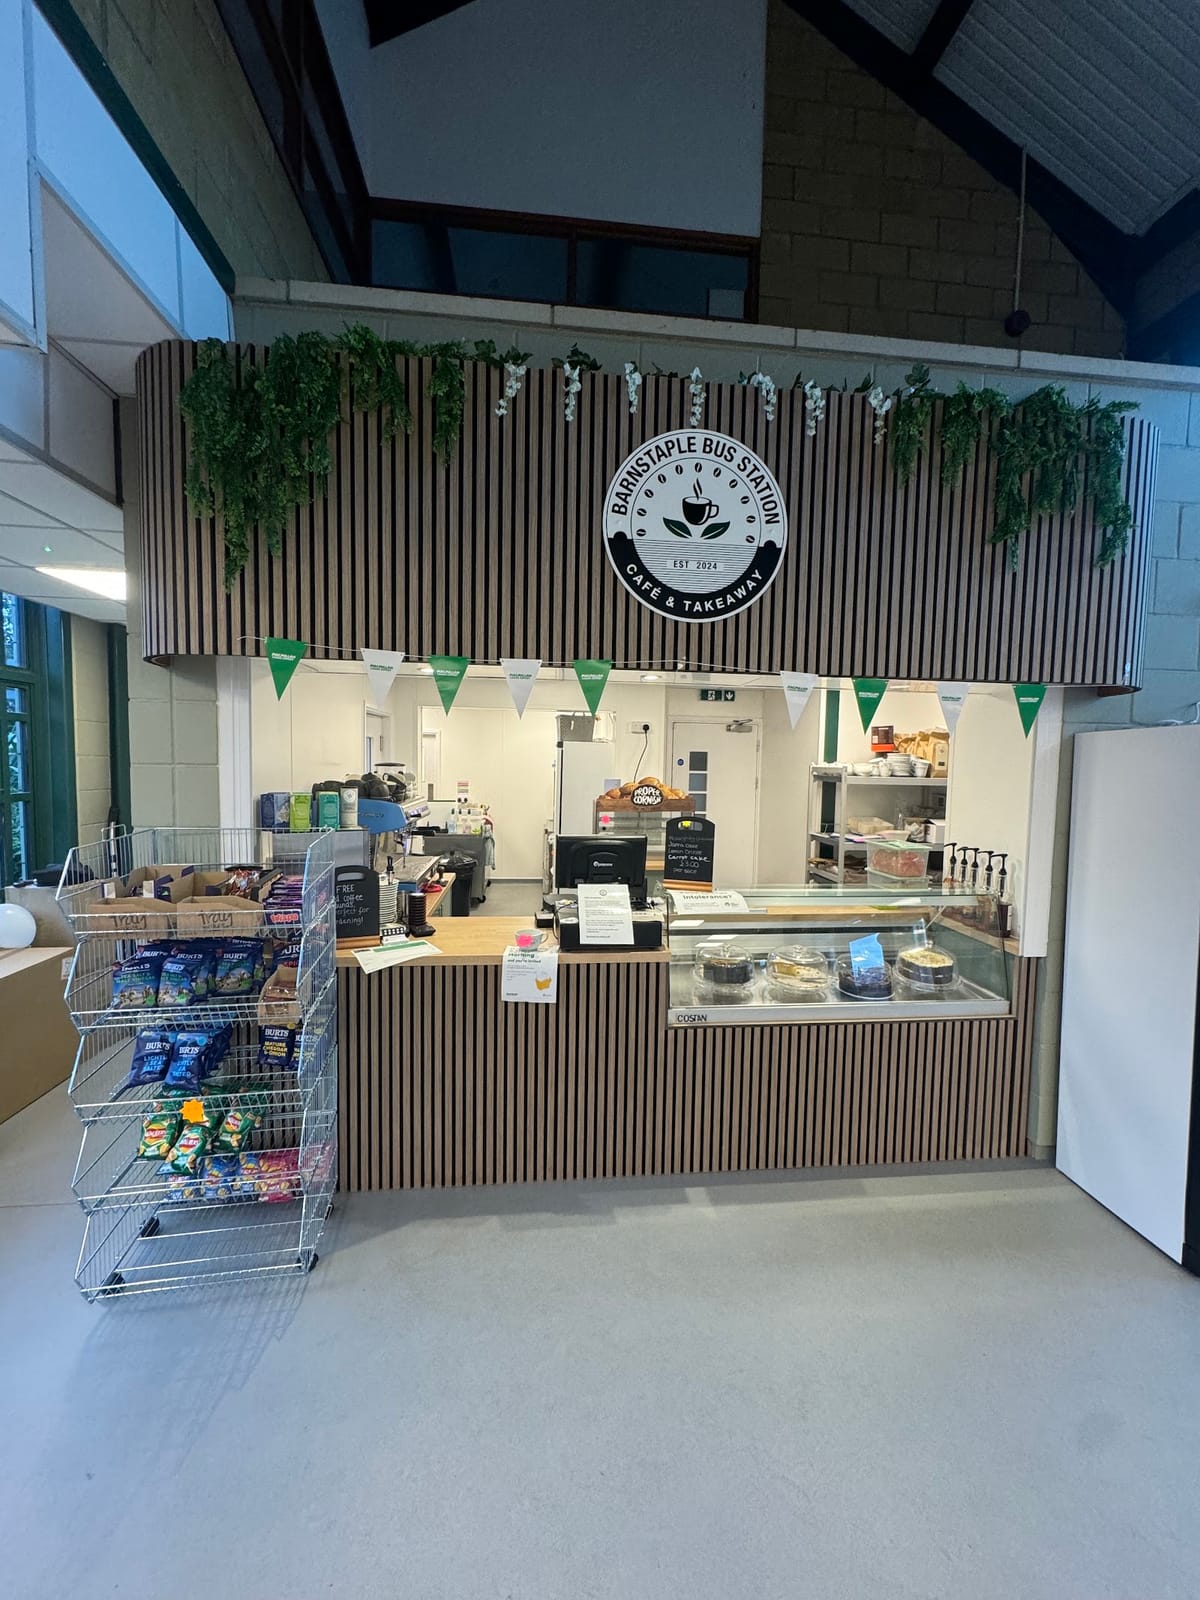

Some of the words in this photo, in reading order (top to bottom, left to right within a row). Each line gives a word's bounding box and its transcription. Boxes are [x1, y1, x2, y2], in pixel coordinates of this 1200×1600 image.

[612, 436, 697, 515] BARNSTAPLE
[702, 437, 737, 463] BUS
[737, 456, 780, 525] STATION
[673, 560, 689, 569] EST
[696, 561, 718, 570] 2024
[626, 563, 662, 600] CAFÉ
[665, 596, 675, 608] &
[683, 569, 763, 612] TAKEAWAY
[634, 787, 661, 796] PROPER
[633, 795, 662, 805] CORNISH
[336, 884, 355, 893] FREE
[343, 894, 364, 903] coffee
[110, 915, 147, 929] Tray
[198, 911, 234, 928] Tray
[677, 1014, 707, 1023] COSTAN
[264, 1028, 290, 1037] BURTS
[145, 1041, 170, 1050] BURTS
